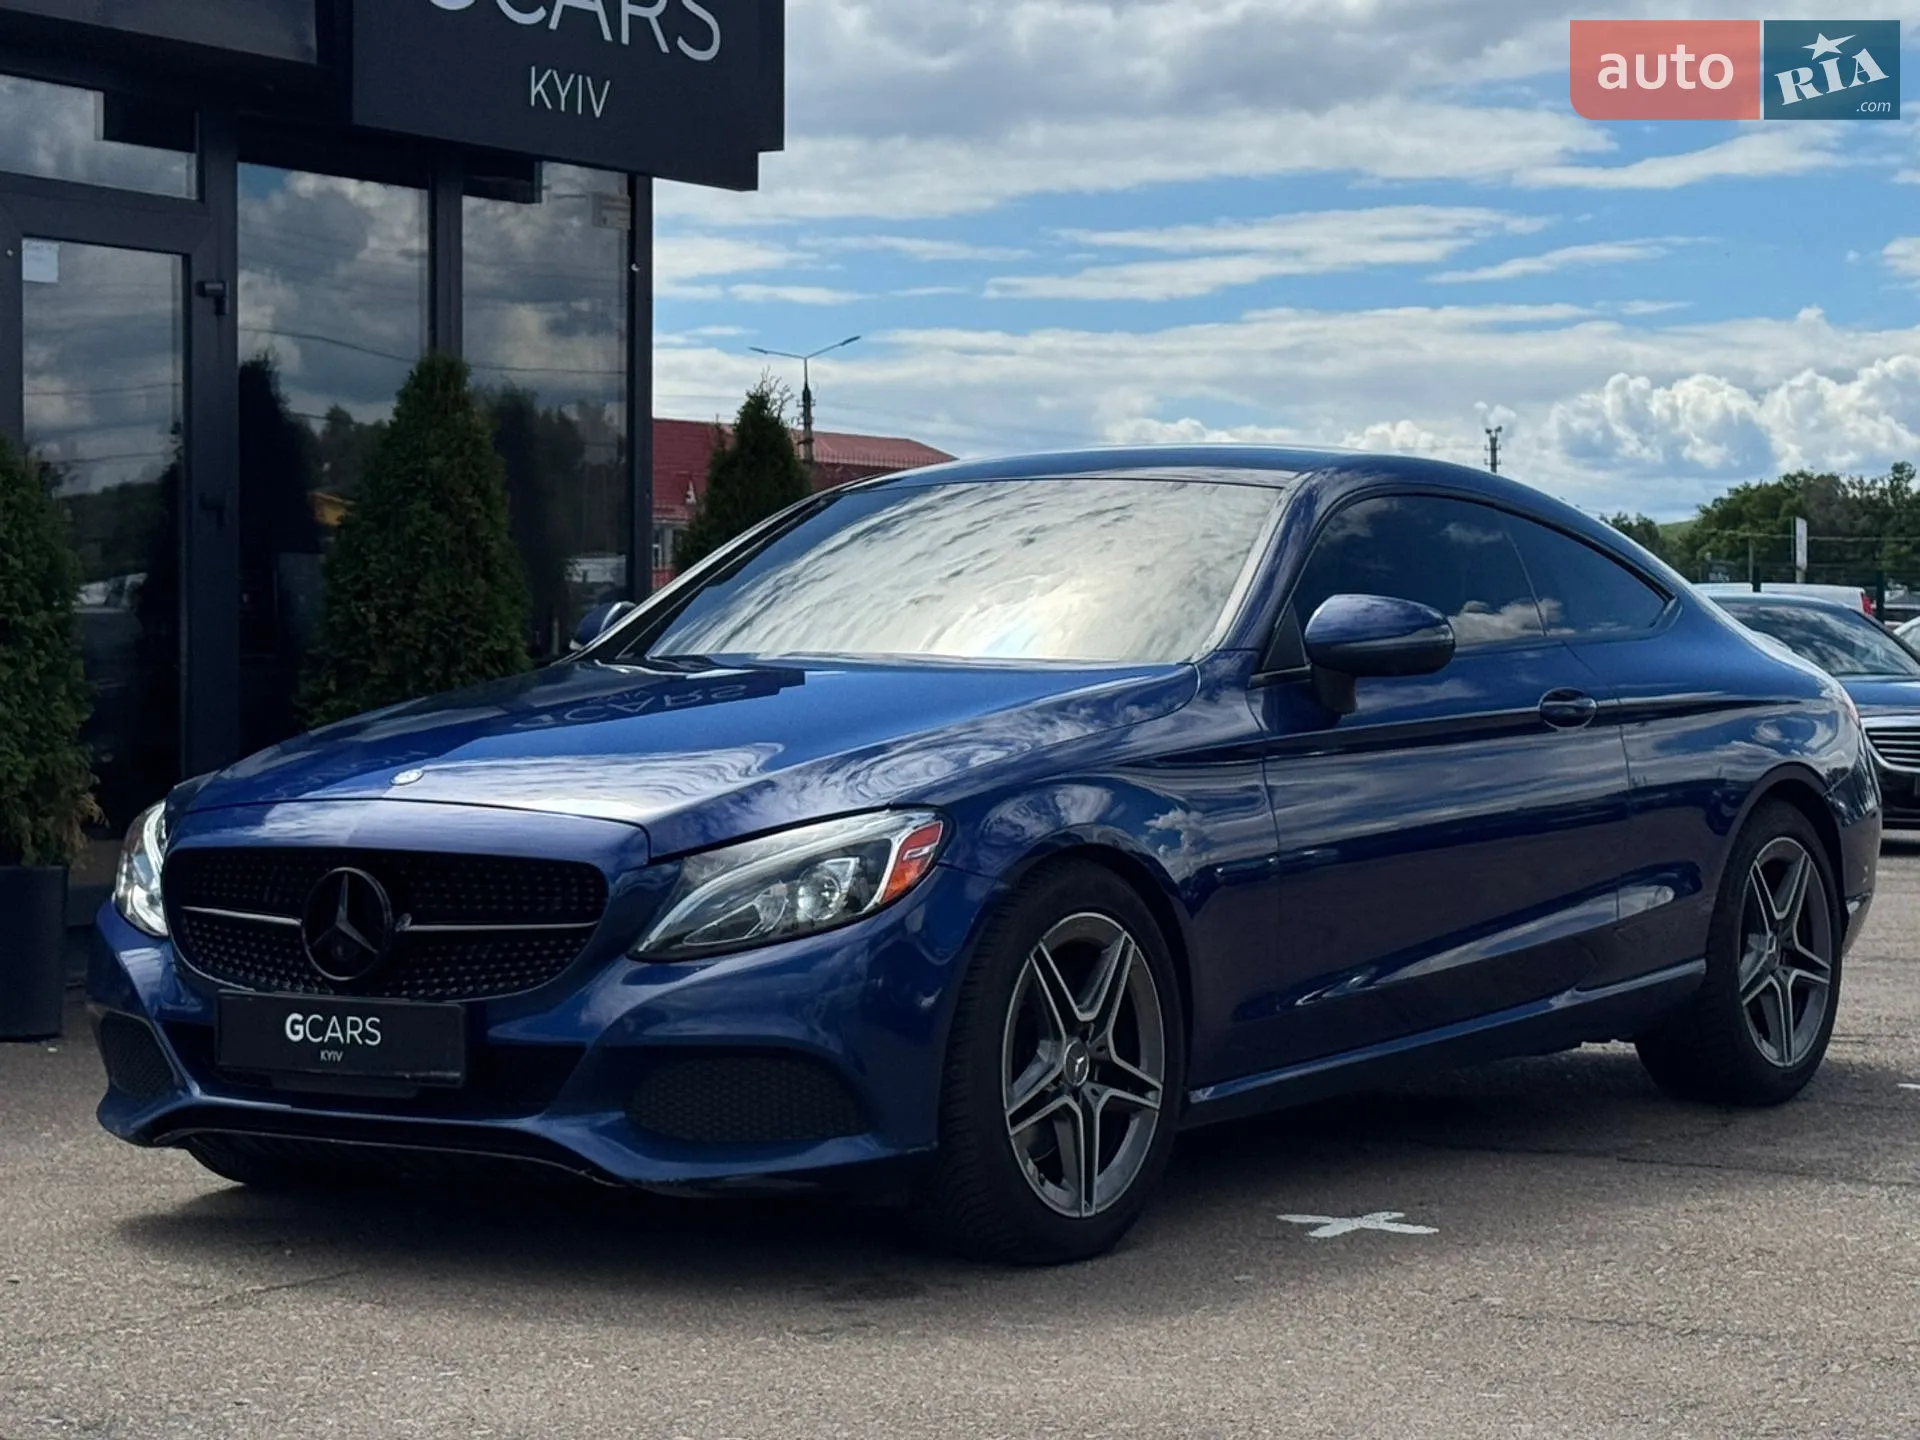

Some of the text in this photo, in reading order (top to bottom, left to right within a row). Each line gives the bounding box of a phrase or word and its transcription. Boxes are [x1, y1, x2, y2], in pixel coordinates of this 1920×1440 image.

[429, 0, 721, 61] ARS
[530, 65, 611, 118] KYIV
[284, 1012, 382, 1046] GCARS
[319, 1049, 344, 1063] KYIV
